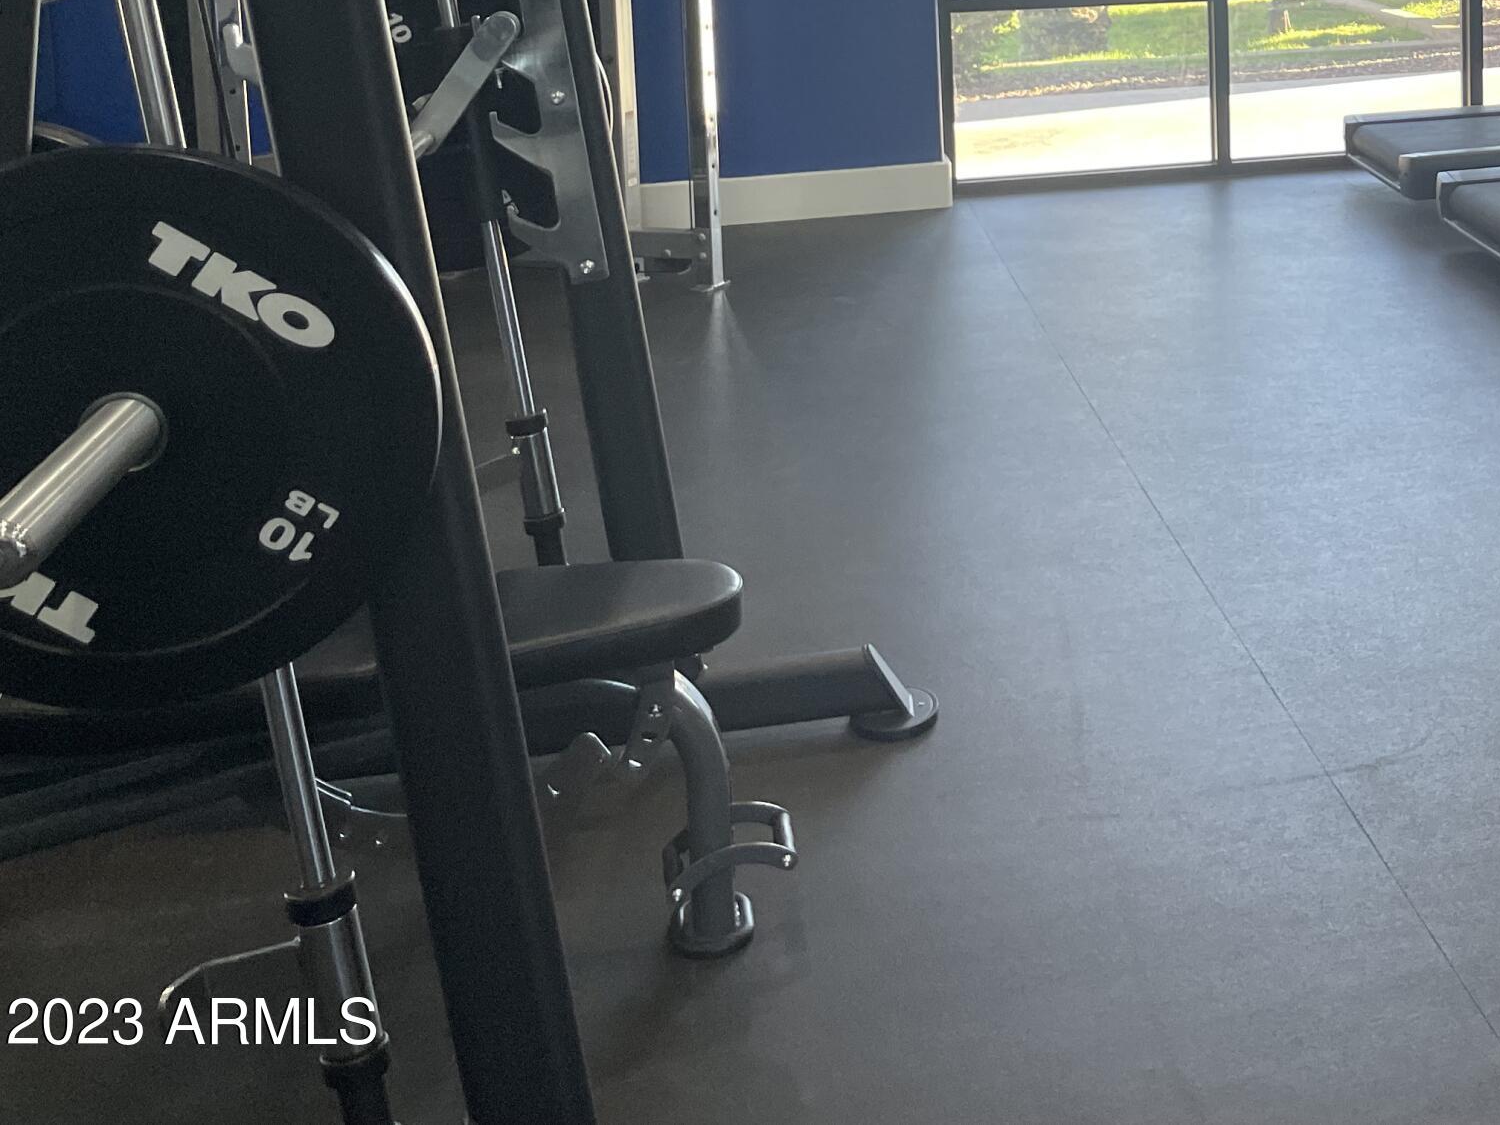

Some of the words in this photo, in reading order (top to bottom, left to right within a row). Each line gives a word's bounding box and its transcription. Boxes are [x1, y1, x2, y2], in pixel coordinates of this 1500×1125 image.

[148, 220, 336, 348] TKO
[285, 490, 340, 529] LB
[259, 517, 315, 561] 10
